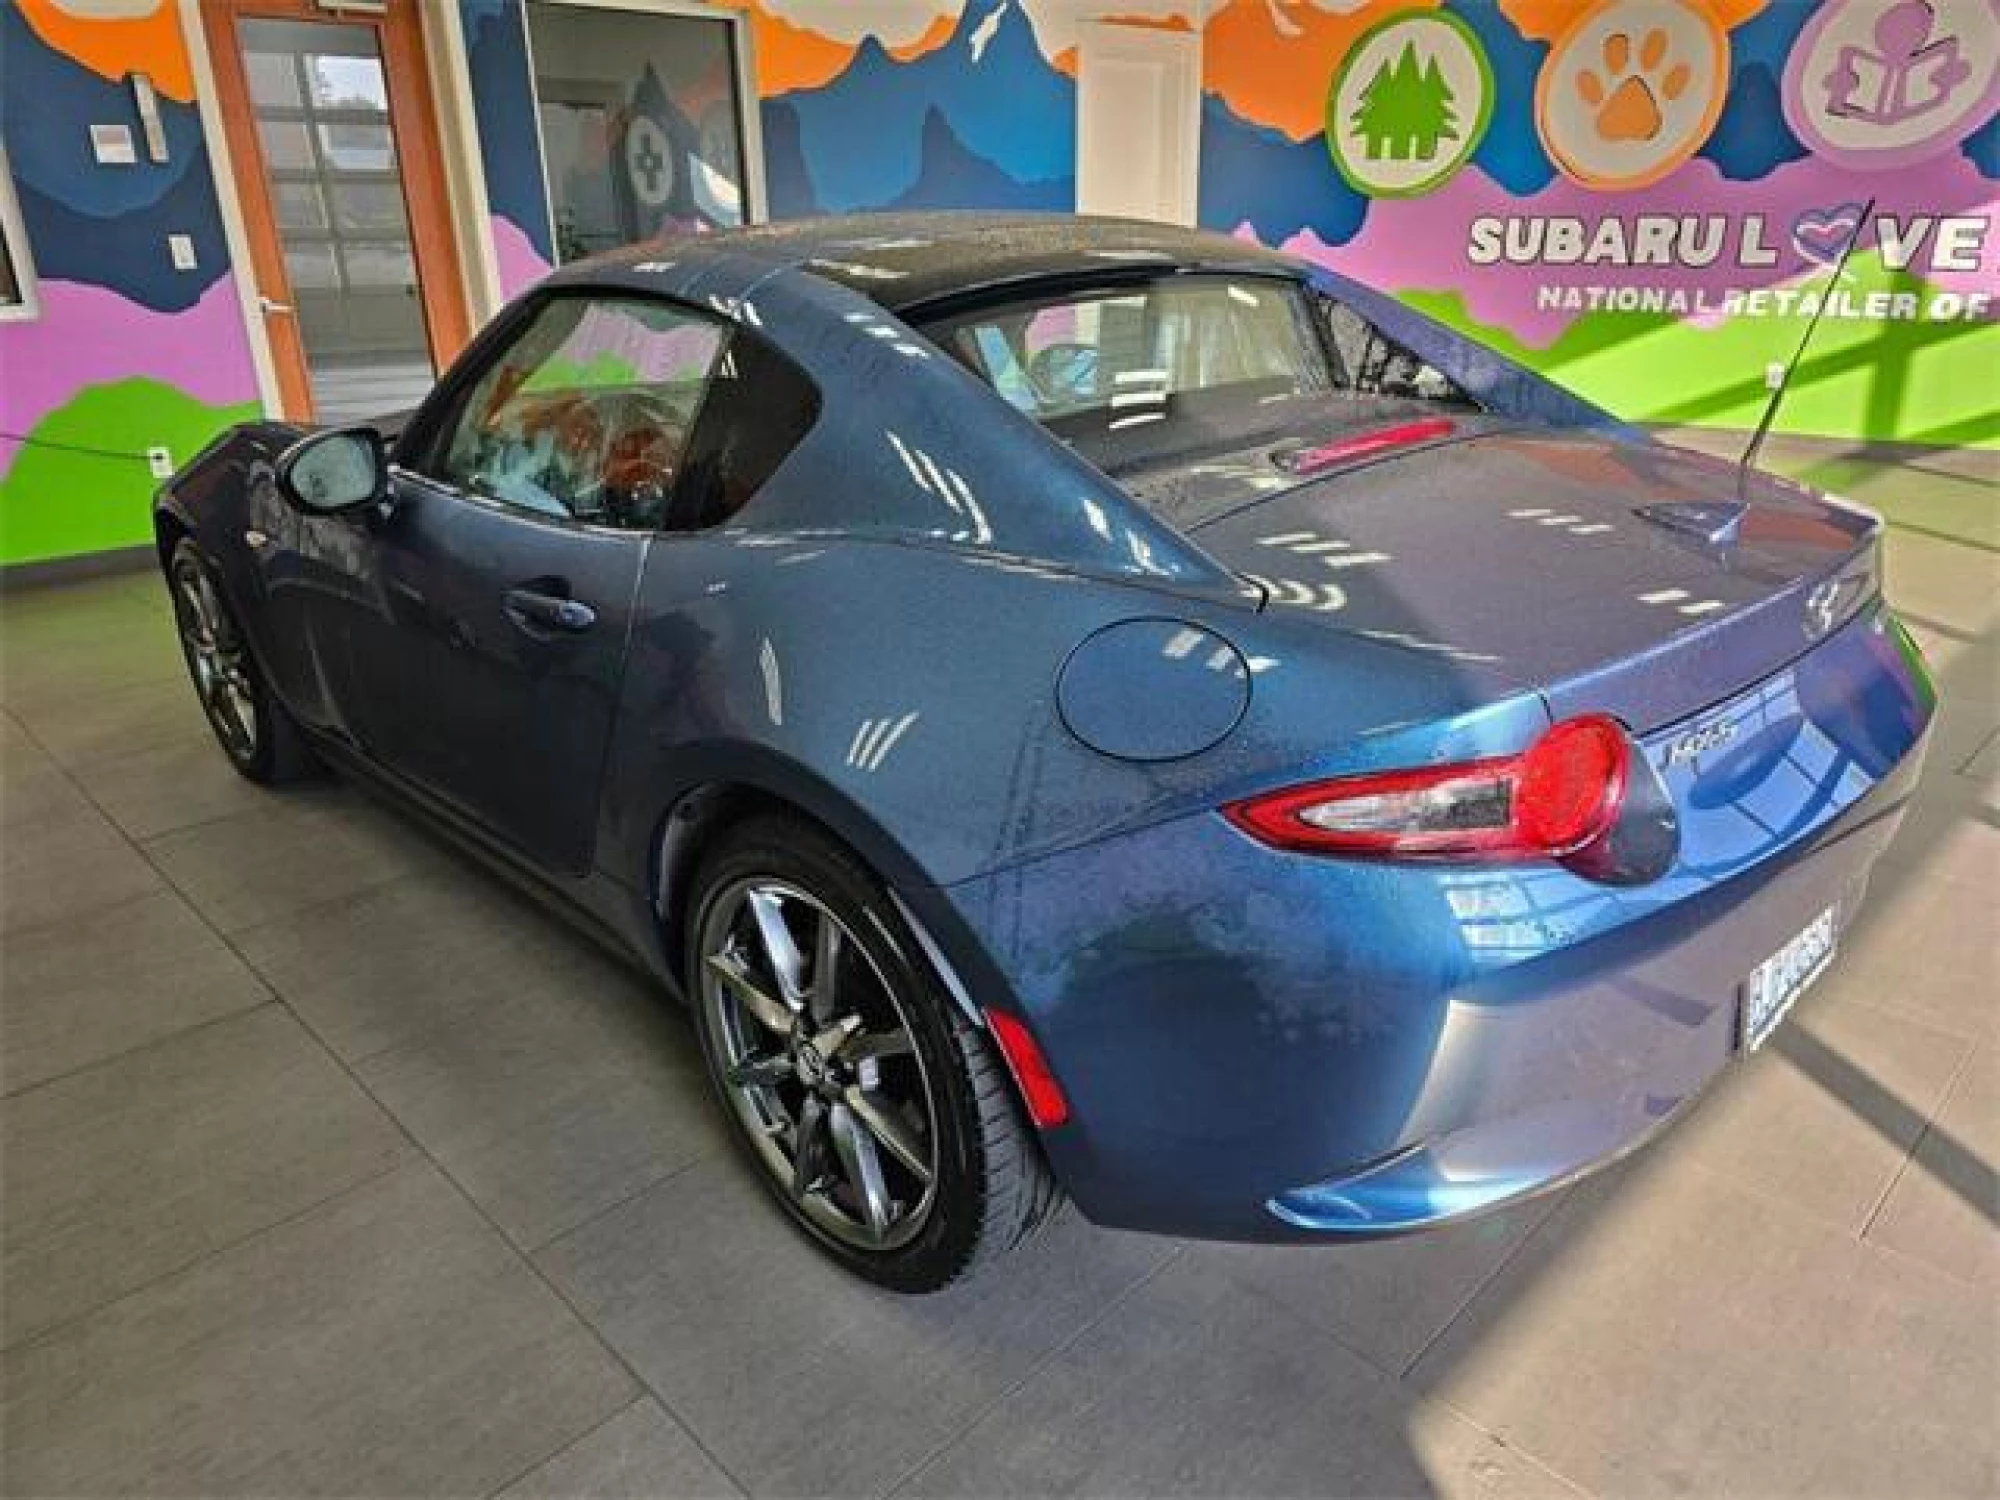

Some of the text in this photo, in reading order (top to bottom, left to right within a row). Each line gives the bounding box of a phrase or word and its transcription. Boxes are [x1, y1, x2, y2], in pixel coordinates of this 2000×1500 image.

[1467, 215, 1728, 267] SUBARU
[1537, 286, 1992, 320] NATIONAL RETAILER OF
